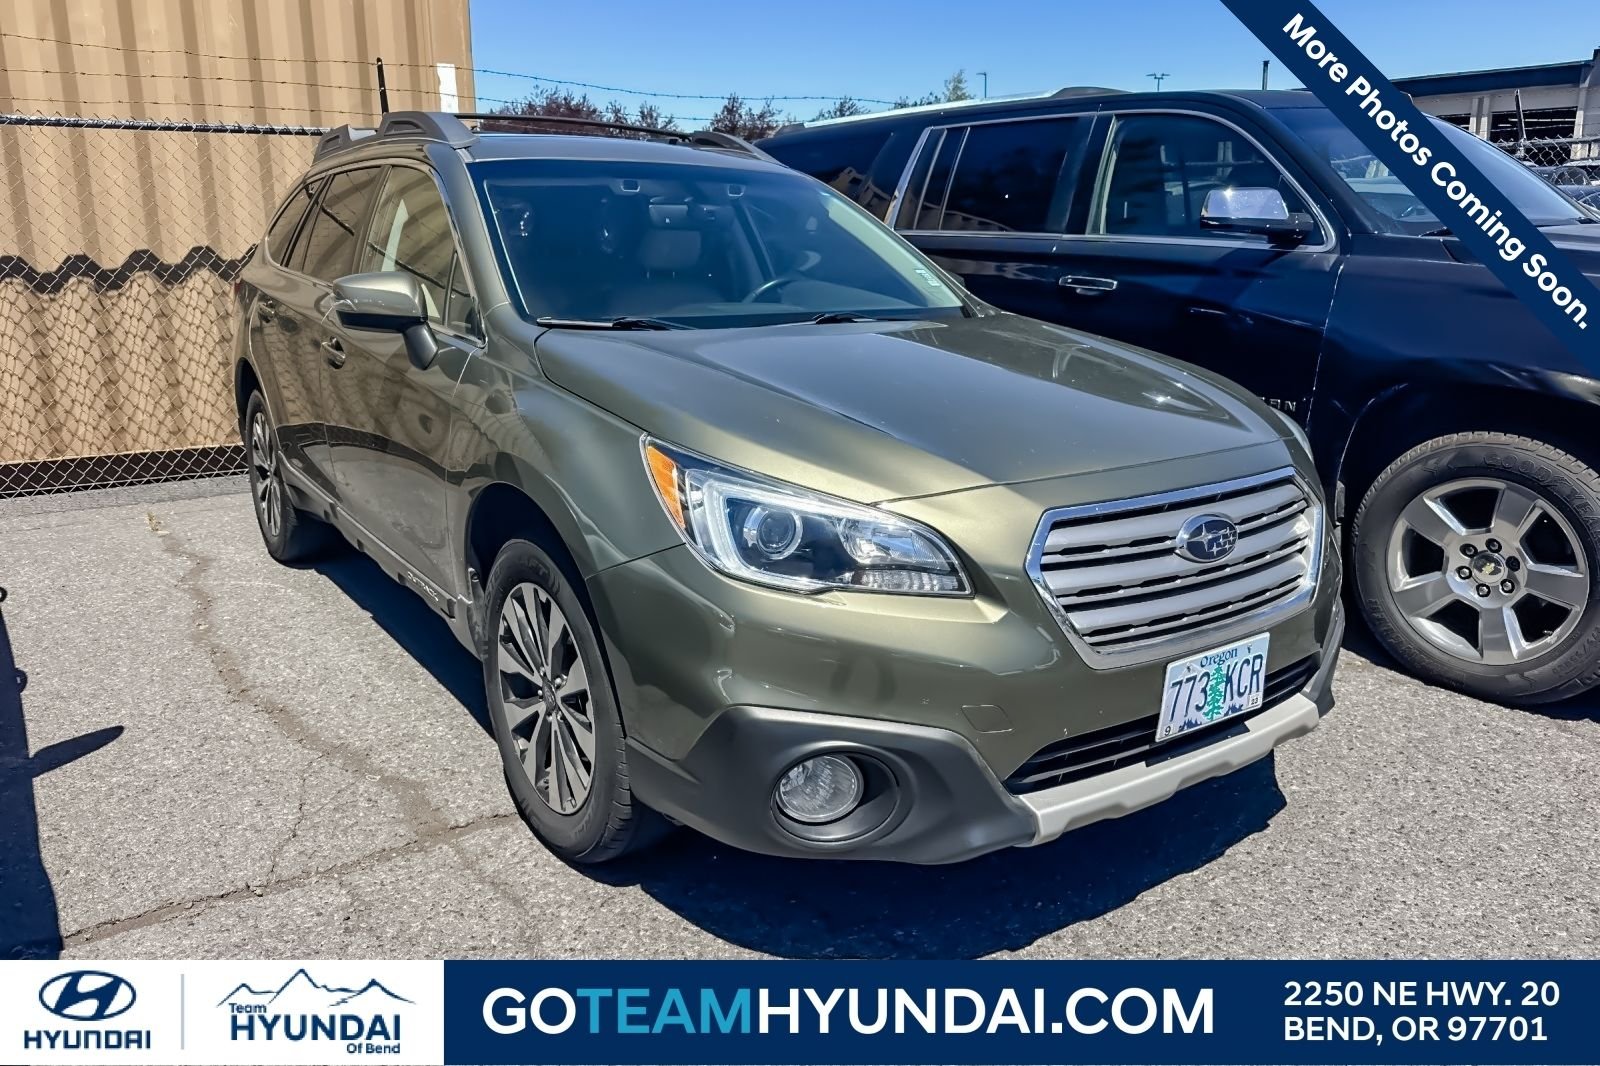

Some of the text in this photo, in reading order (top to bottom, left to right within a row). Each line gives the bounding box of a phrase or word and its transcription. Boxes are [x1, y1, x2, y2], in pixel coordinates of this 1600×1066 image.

[1200, 647, 1238, 669] Oregon
[1169, 653, 1263, 722] 773 KCR
[1164, 725, 1172, 736] 9
